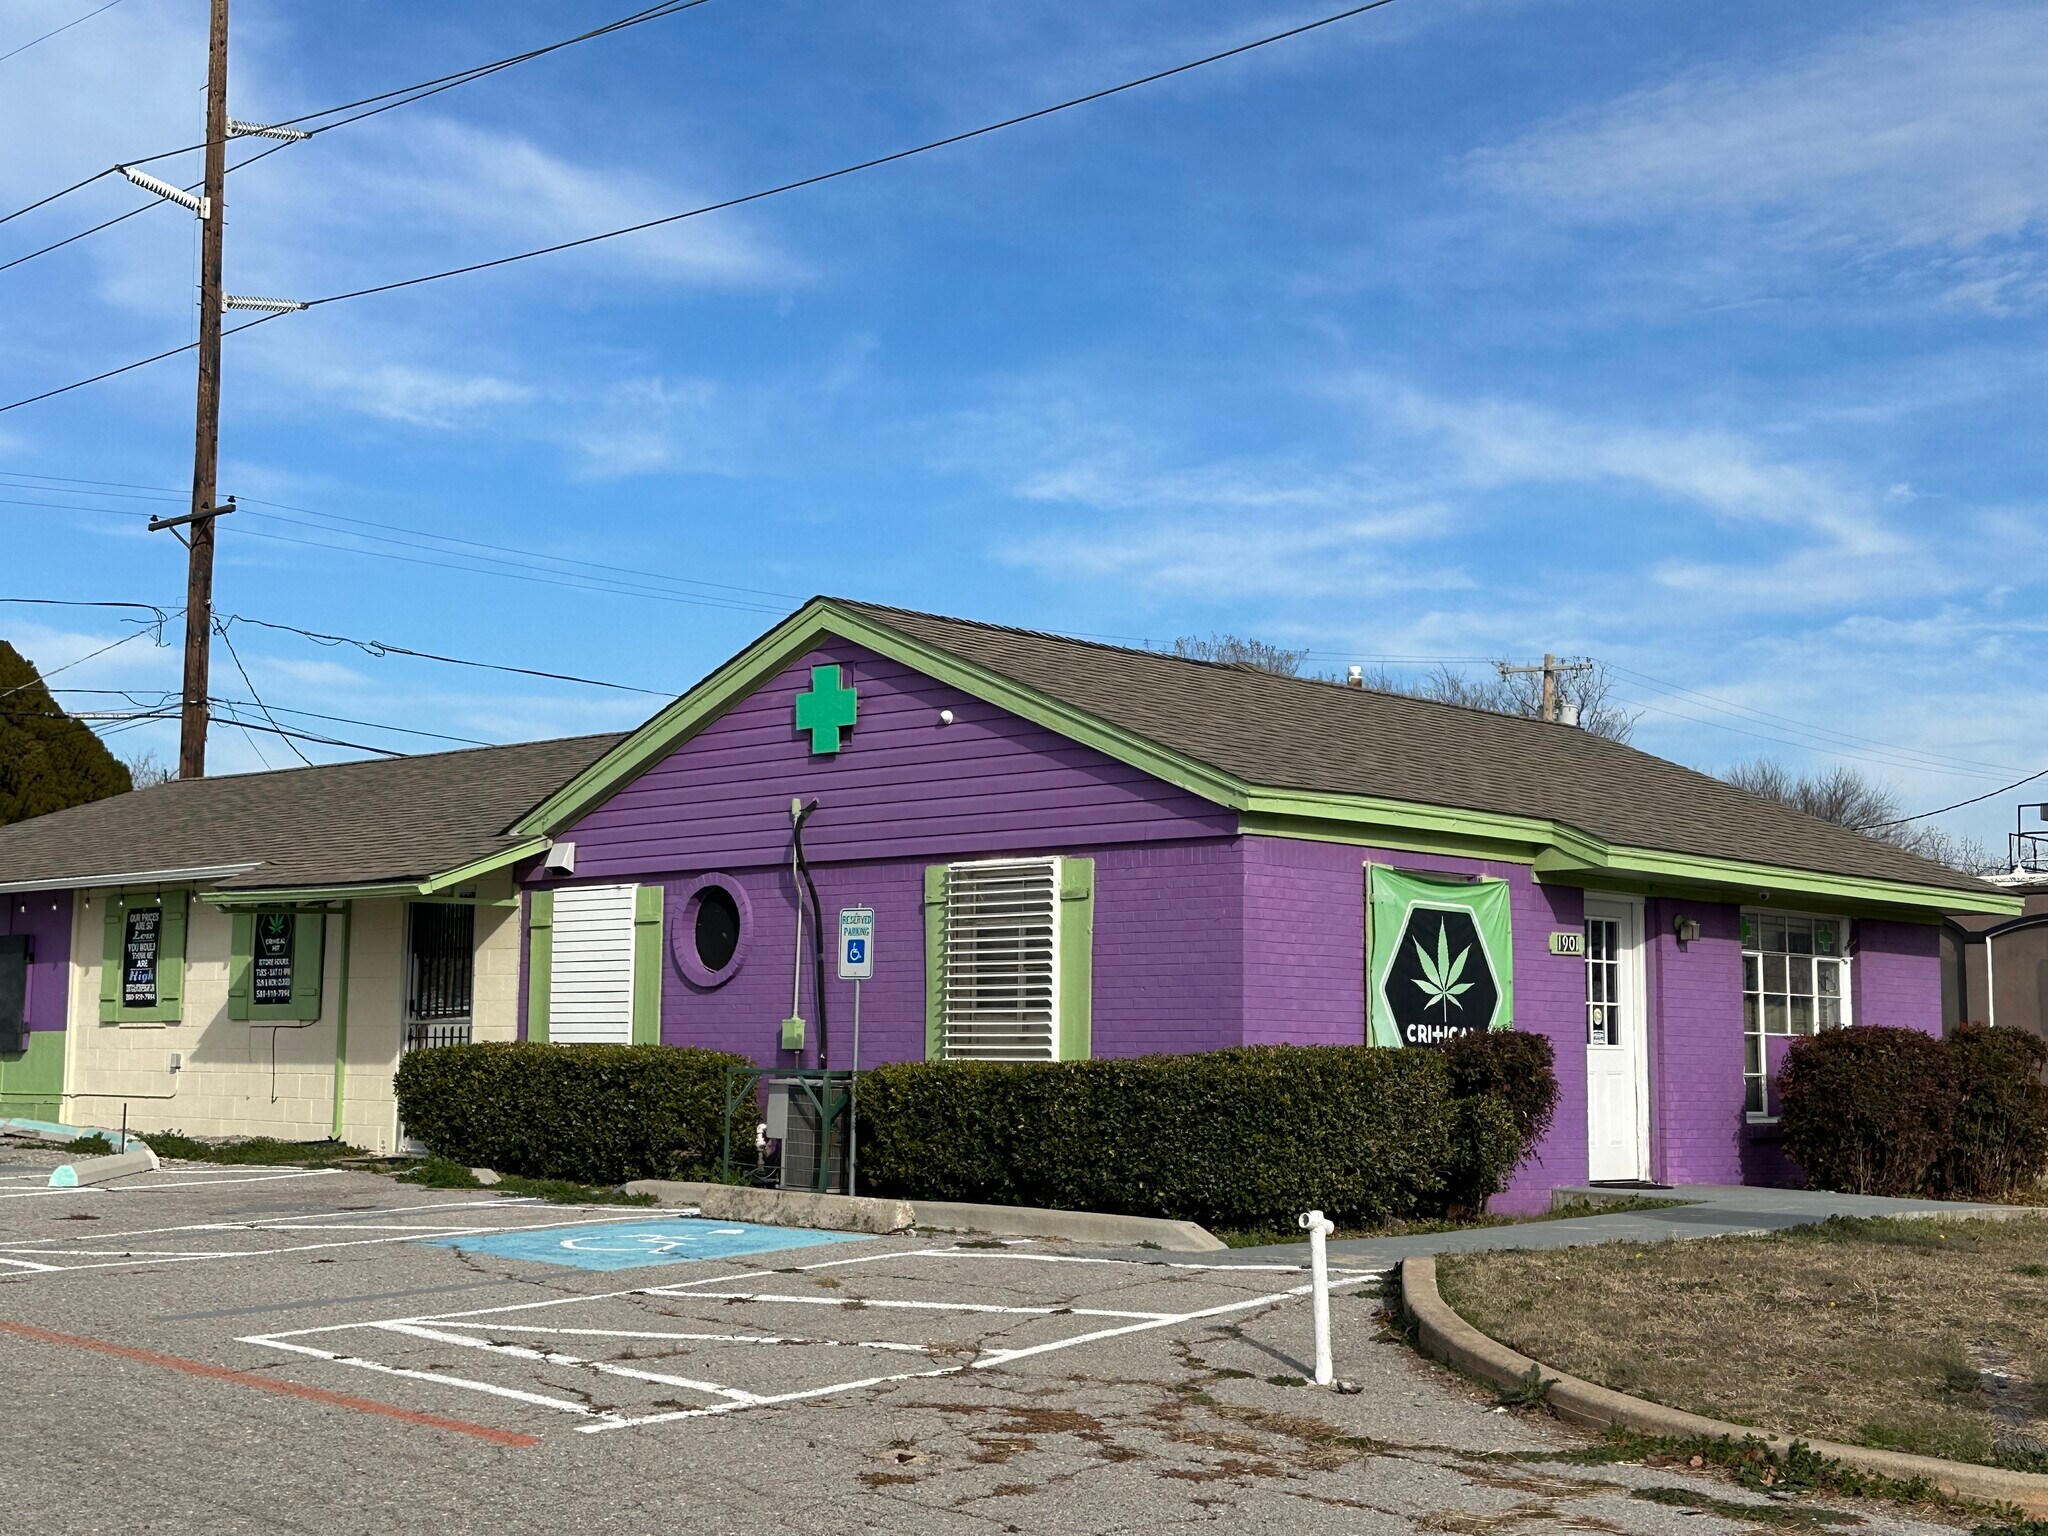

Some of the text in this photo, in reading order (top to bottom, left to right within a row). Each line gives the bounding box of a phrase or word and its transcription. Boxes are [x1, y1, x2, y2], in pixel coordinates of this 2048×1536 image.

[130, 913, 159, 922] OUR PRICES
[842, 915, 872, 924] RESERVED
[135, 921, 153, 930] ARE SO
[132, 931, 155, 940] Low
[844, 927, 870, 936] PARKING
[128, 942, 156, 952] YOU WOULD
[1557, 935, 1580, 952] 1901
[132, 952, 146, 960] THINK
[136, 959, 148, 967] ARE
[129, 970, 154, 983] High
